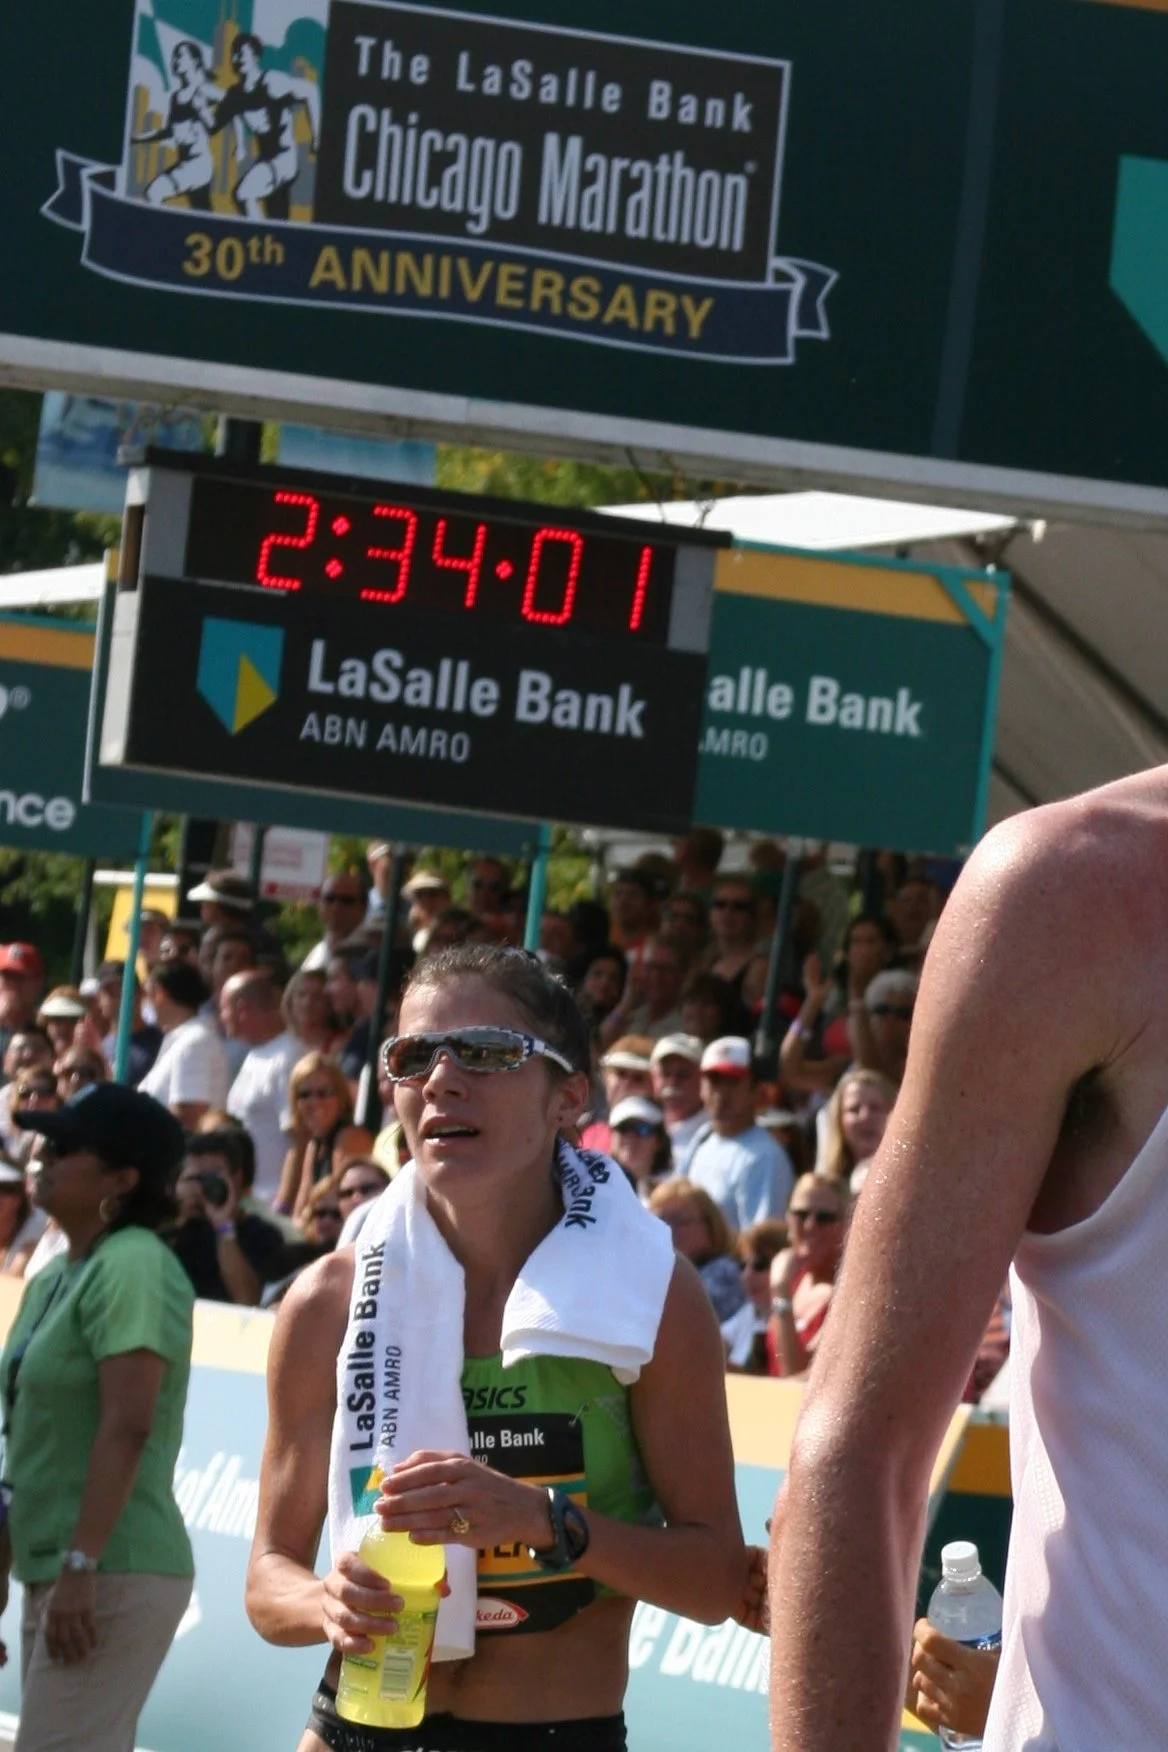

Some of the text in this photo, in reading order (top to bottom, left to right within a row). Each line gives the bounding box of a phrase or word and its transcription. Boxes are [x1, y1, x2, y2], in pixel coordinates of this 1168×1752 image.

[354, 36, 755, 134] The LaSalle Bank
[342, 104, 748, 252] Chicago Marathon
[182, 232, 716, 340] 30th ANNIVERSARY
[300, 711, 471, 765] ABN AMRO
[307, 640, 647, 740] LaSalle Bank
[805, 674, 924, 737] Bank
[698, 726, 769, 762] MRO
[346, 1240, 386, 1452] LaSalle Bank
[380, 1345, 403, 1449] ABN AMRO
[499, 1427, 546, 1448] Bank
